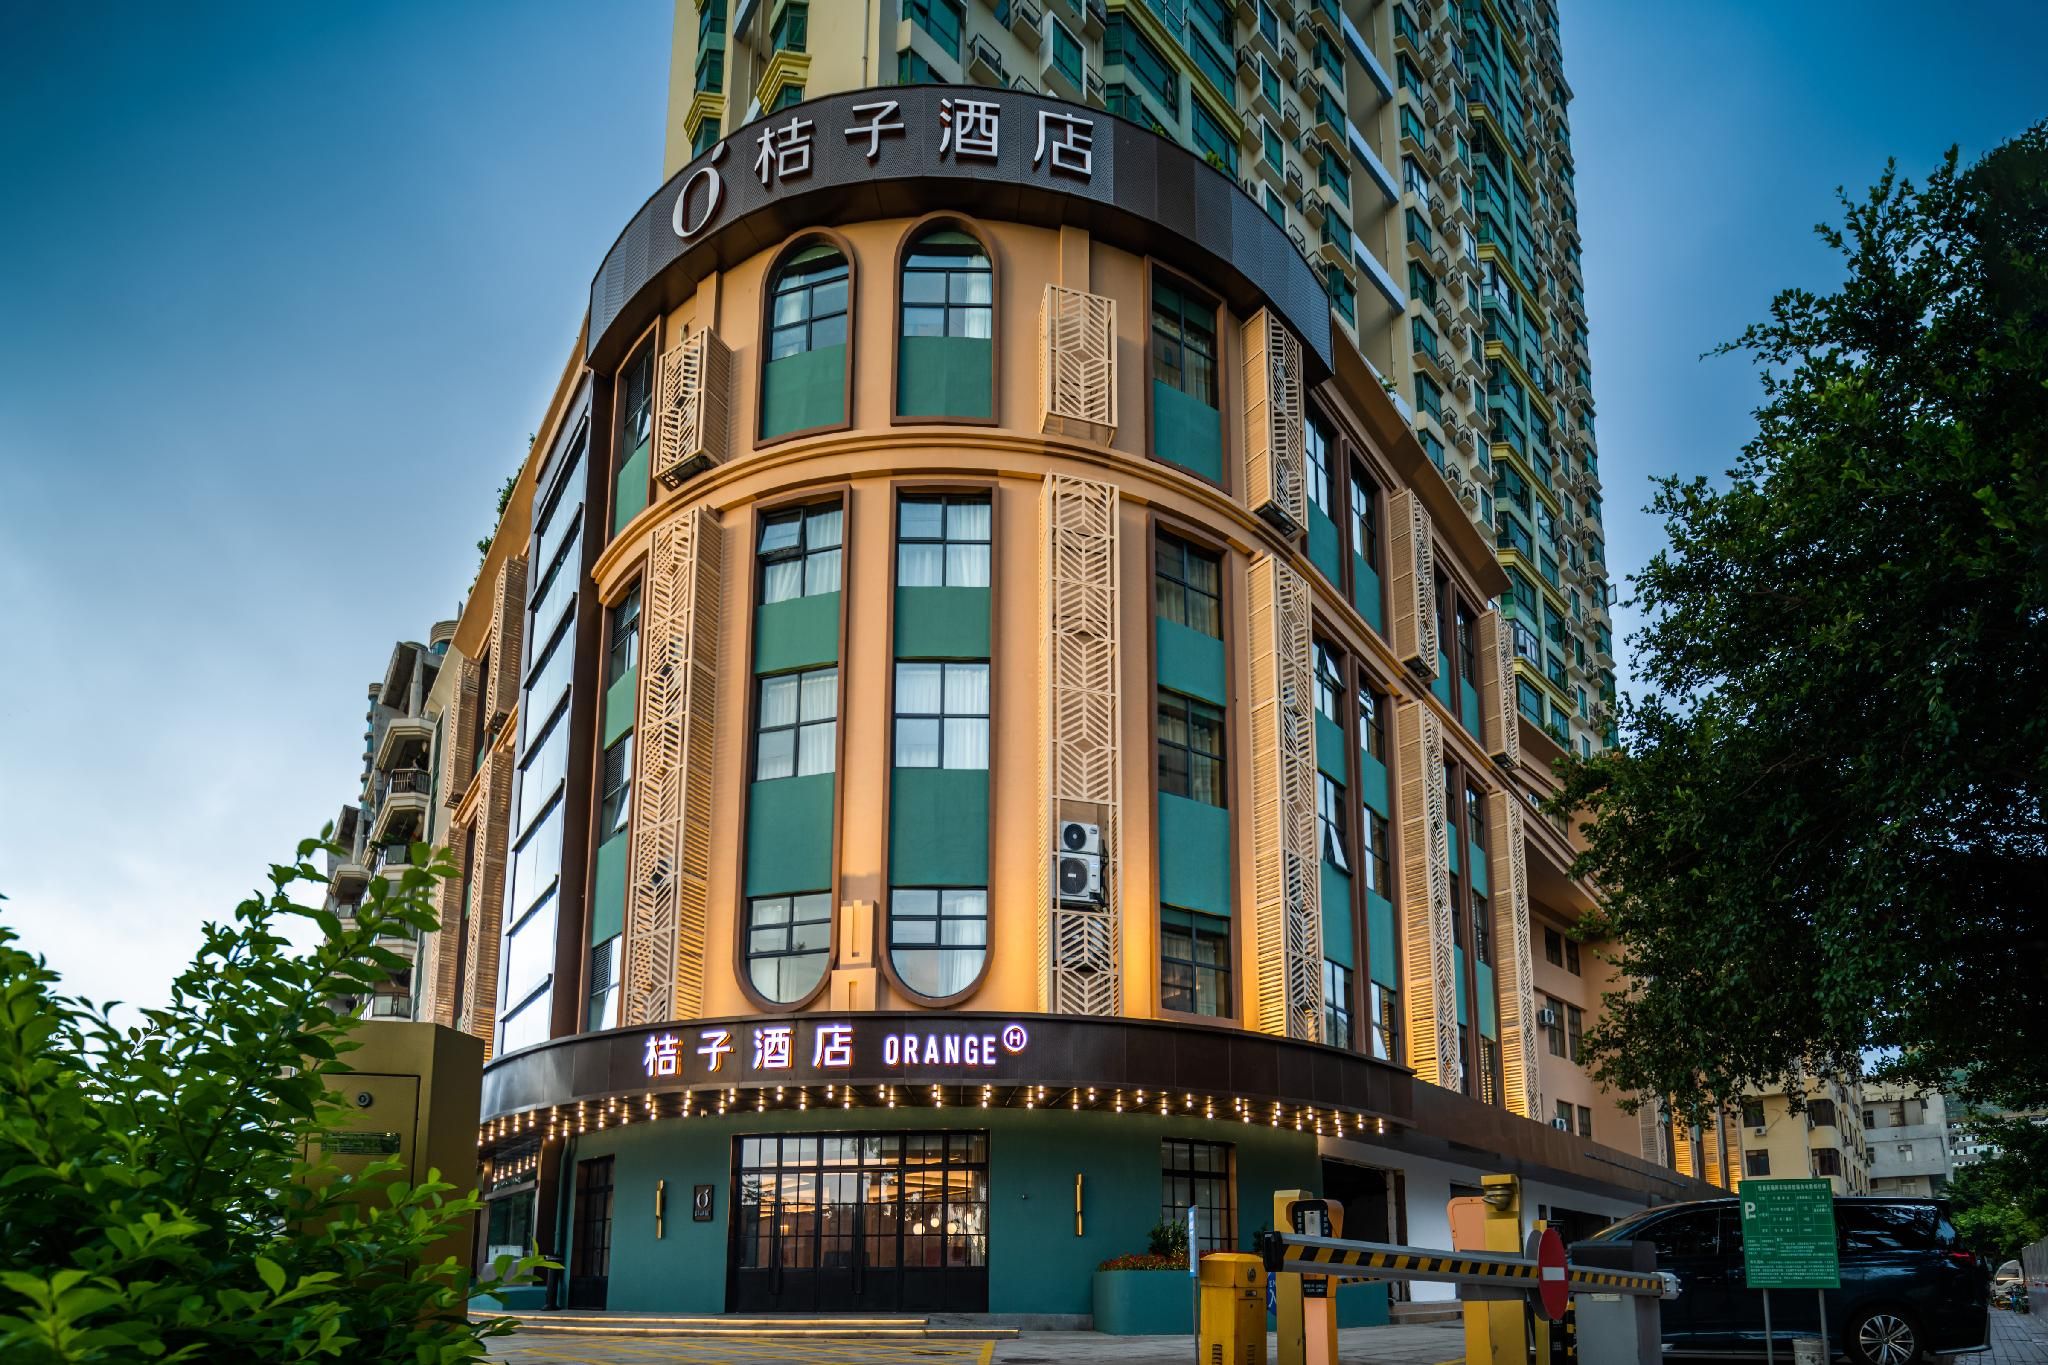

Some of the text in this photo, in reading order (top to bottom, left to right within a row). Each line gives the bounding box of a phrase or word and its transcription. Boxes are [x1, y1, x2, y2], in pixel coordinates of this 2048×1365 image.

[755, 98, 1093, 184] 桔子酒店
[644, 1024, 853, 1077] 桔子酒店
[885, 1036, 996, 1065] ORANGE
